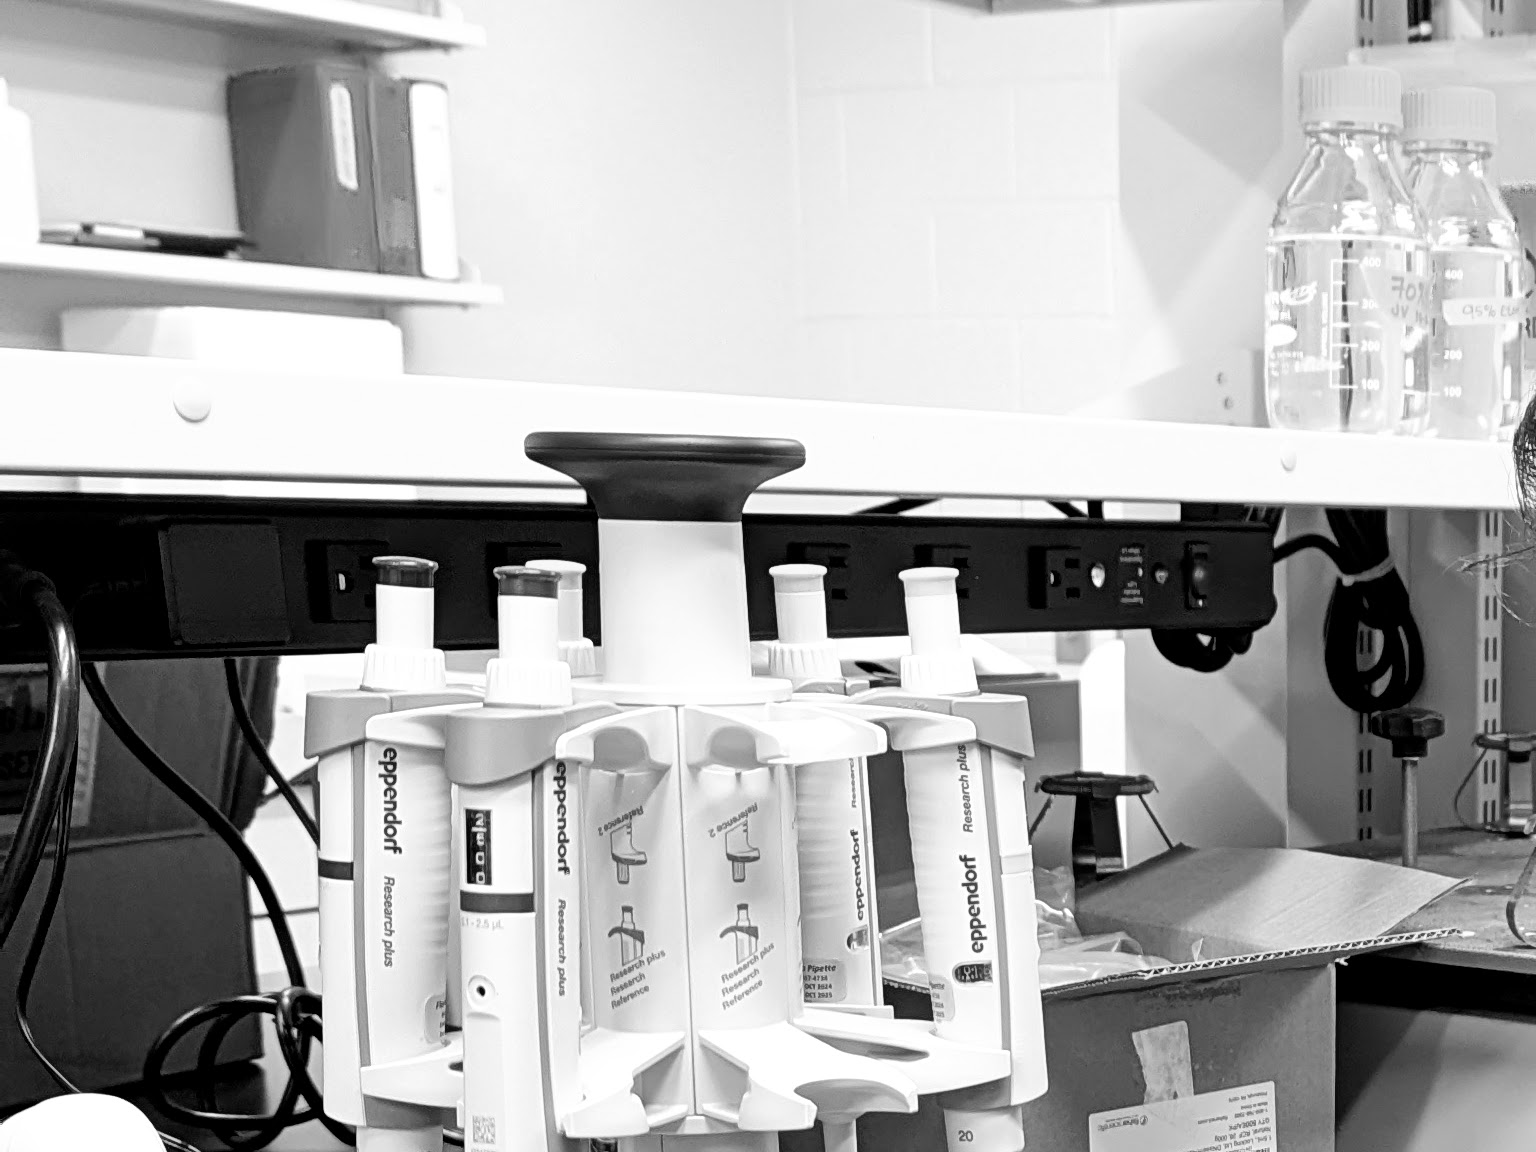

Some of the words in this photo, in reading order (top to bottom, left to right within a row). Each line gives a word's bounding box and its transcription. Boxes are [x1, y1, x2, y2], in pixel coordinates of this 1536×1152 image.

[957, 744, 968, 773] plus
[379, 747, 403, 855] eppendorf
[961, 774, 974, 833] Research
[553, 761, 570, 876] eppendorf
[602, 805, 645, 833] Reference
[716, 802, 759, 833] Reference
[708, 828, 716, 839] 2
[851, 829, 866, 921] eppendorf
[382, 875, 396, 938] Research
[959, 854, 988, 954] eppendorf
[557, 898, 566, 963] Research
[381, 939, 394, 968] plus
[609, 958, 646, 983] Research
[646, 949, 666, 966] plus
[721, 954, 760, 983] Research
[759, 941, 775, 961] plus
[557, 967, 566, 997] plus
[610, 972, 646, 996] Research
[611, 984, 650, 1009] Reference
[721, 967, 760, 998] Research
[722, 979, 764, 1010] Reference
[958, 1129, 974, 1142] 20
